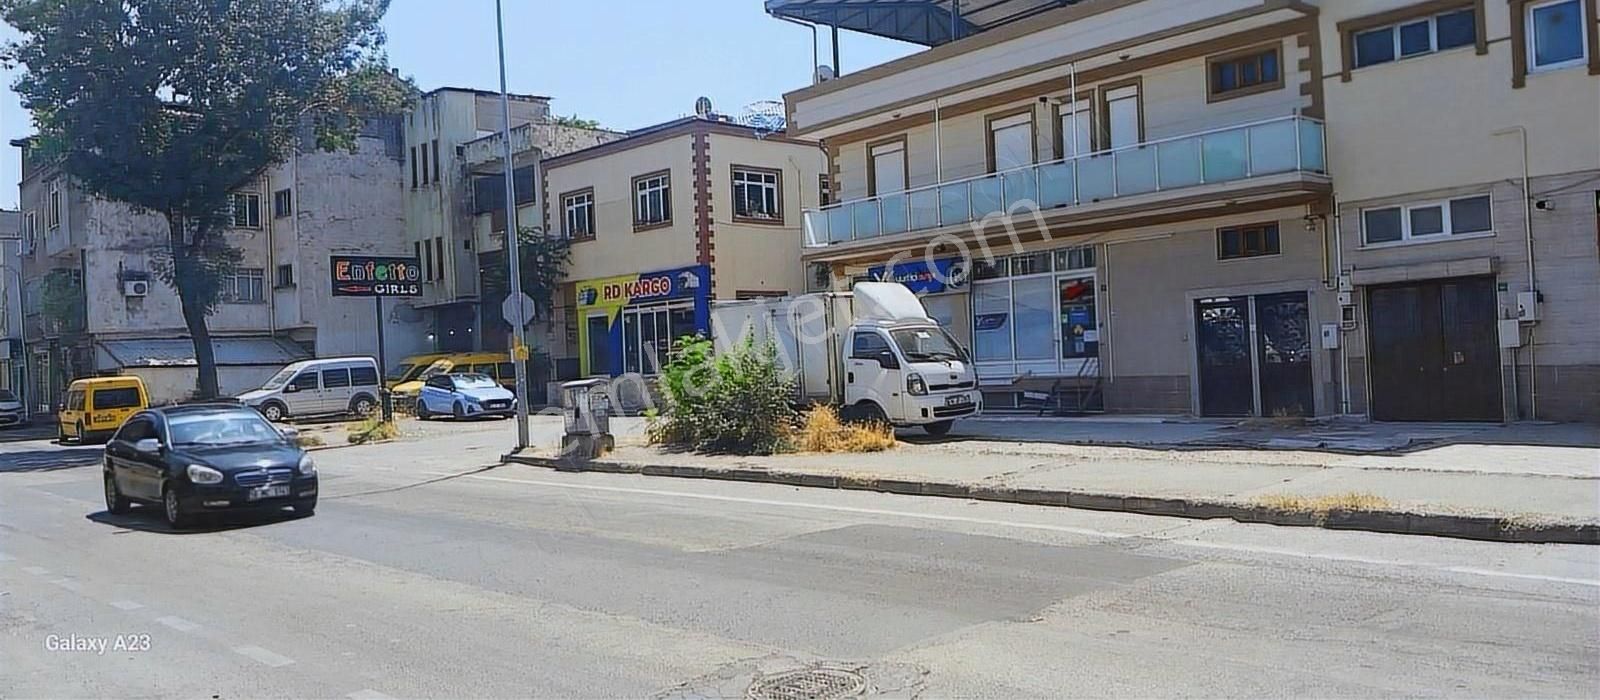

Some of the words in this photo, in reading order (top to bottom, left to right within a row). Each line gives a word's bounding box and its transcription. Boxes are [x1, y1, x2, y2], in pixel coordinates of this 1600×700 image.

[374, 284, 418, 295] GIRLS
[603, 284, 621, 300] RD
[624, 277, 671, 298] KARGO
